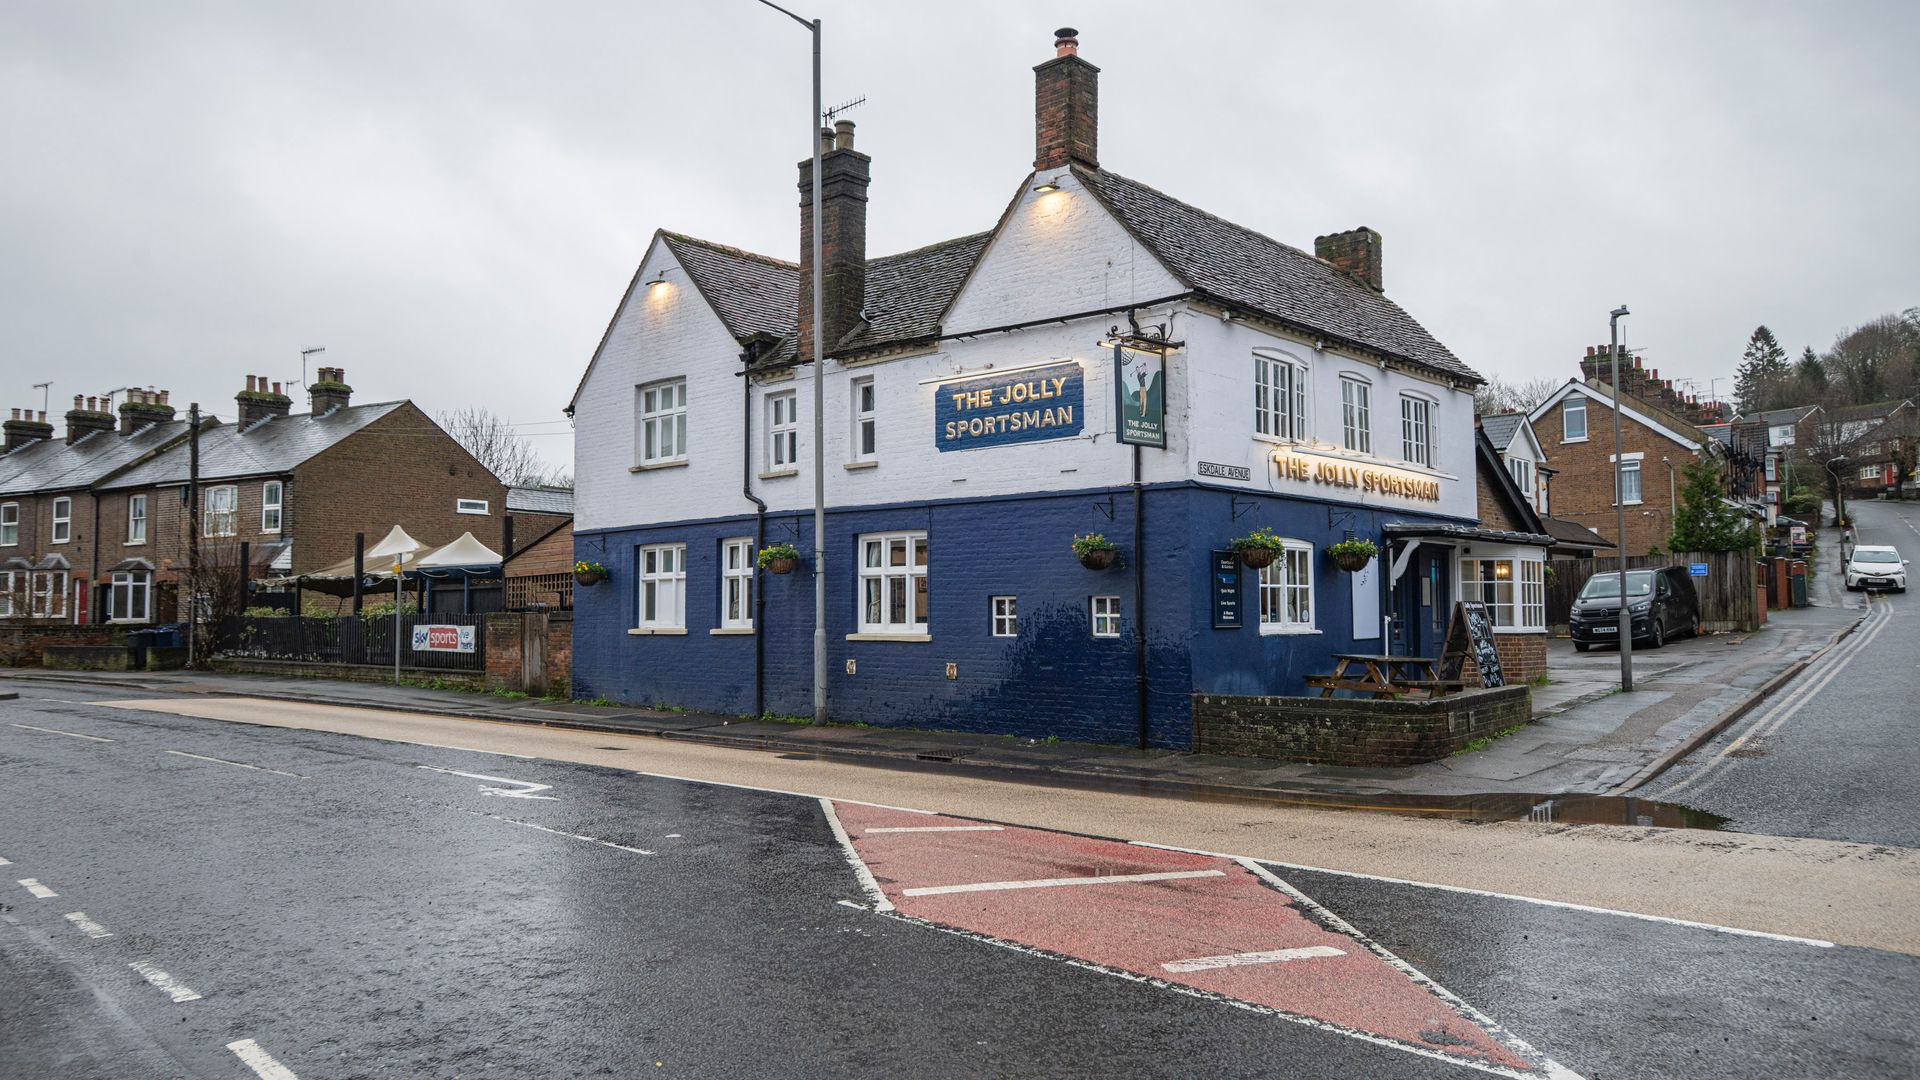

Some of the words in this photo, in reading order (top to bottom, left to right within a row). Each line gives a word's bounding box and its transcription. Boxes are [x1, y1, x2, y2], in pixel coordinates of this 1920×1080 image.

[952, 389, 993, 412] THE
[1000, 377, 1067, 405] JOLLY
[945, 405, 1073, 440] SPORTSMAN
[1127, 419, 1140, 429] THE
[1140, 421, 1158, 430] JOLLY
[1126, 429, 1160, 440] SPORTSMAN
[1199, 463, 1225, 476] ESKDALE
[1227, 467, 1249, 479] AVENUE
[1273, 454, 1310, 481] THE
[1313, 462, 1360, 488] JOLLY
[1363, 469, 1440, 501] SPORTSMAN
[414, 629, 429, 646] sky
[430, 632, 457, 646] sports
